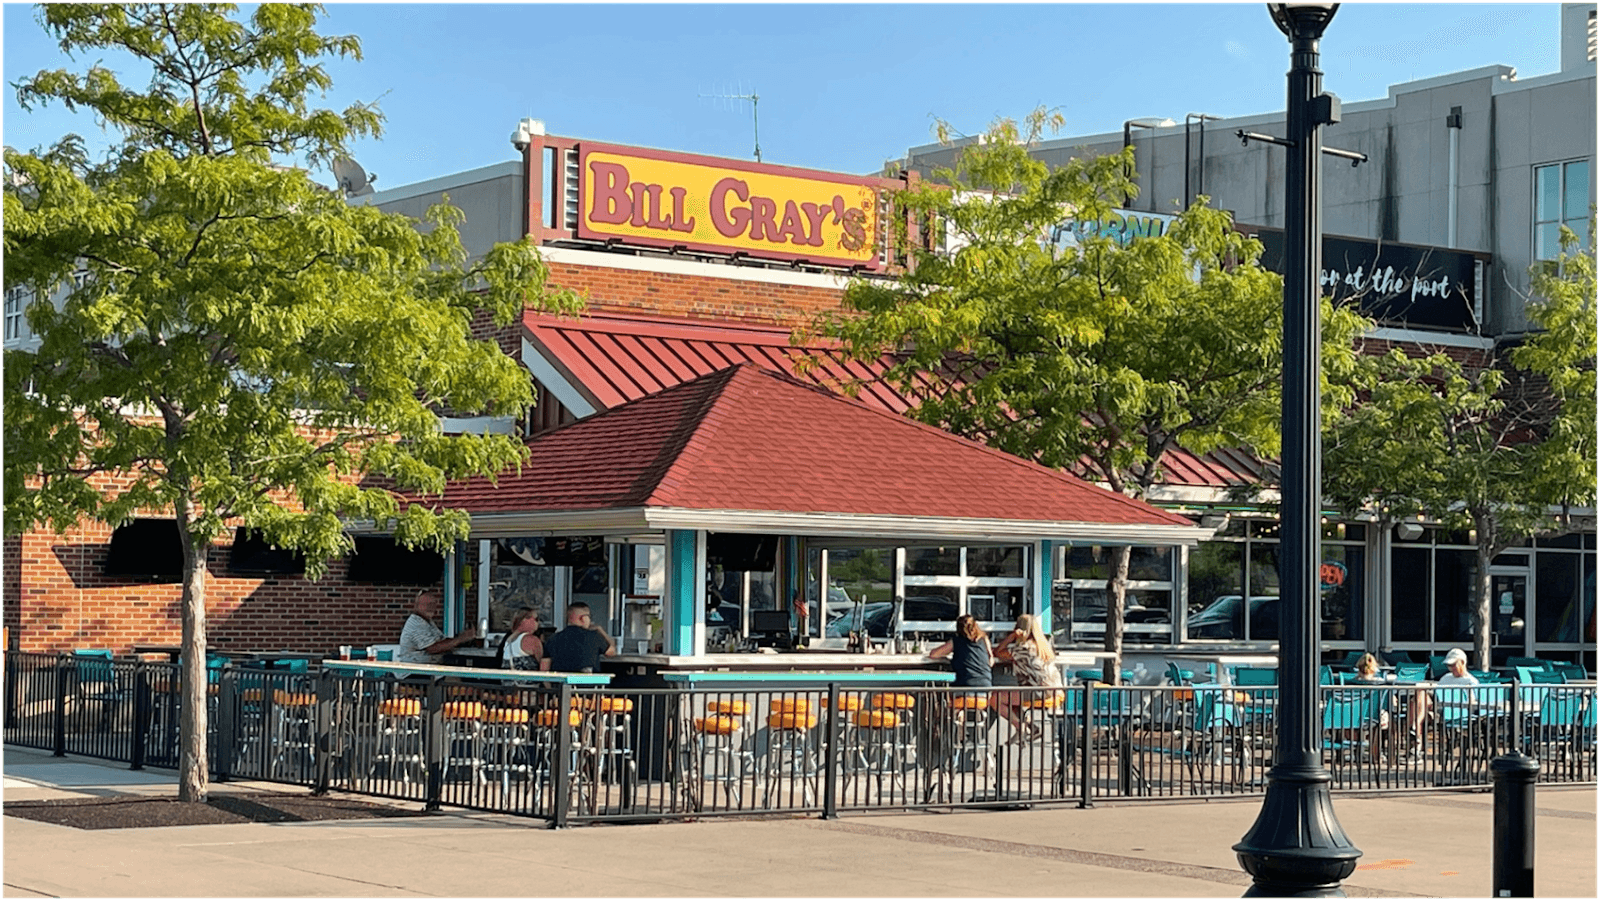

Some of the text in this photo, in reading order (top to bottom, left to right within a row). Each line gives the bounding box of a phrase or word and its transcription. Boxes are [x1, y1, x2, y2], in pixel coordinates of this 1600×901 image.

[589, 160, 867, 252] BILL GRAY'S
[1345, 265, 1365, 290] at
[1372, 265, 1404, 294] the
[1411, 275, 1451, 303] port
[1319, 564, 1344, 586] PEN
